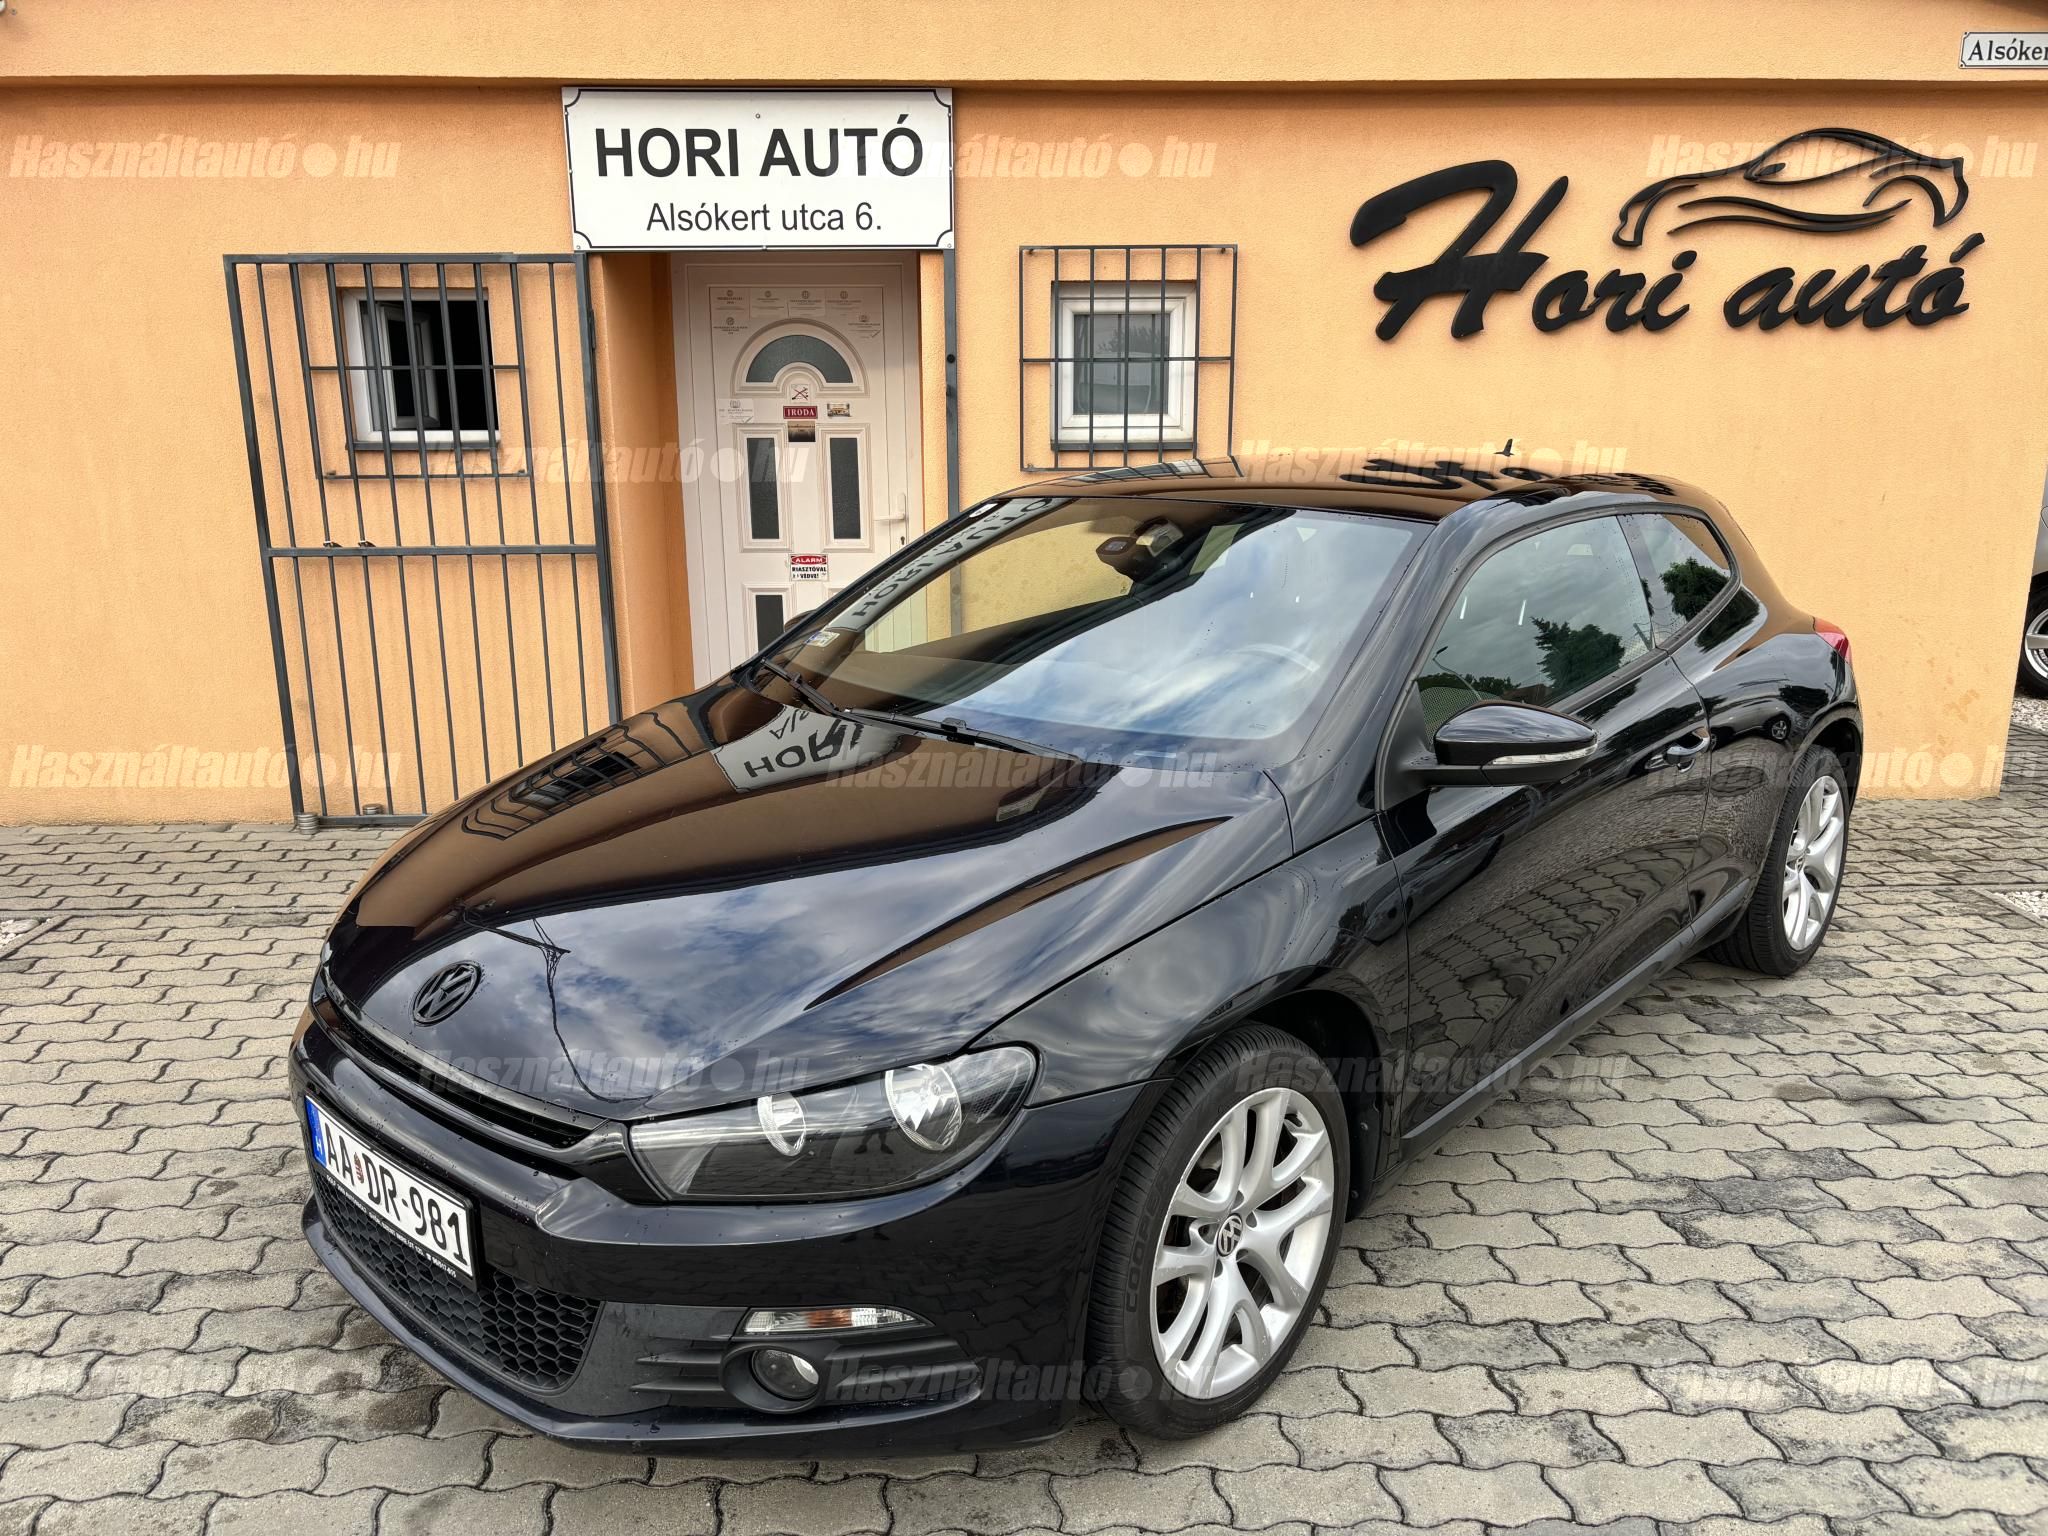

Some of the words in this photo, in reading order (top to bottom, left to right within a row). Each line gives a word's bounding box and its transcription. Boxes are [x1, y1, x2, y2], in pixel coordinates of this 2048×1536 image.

[595, 128, 739, 178] HORI
[759, 114, 923, 178] AUTÓ
[646, 202, 771, 232] Alsókert
[781, 203, 844, 231] utca
[855, 202, 882, 231] 6.
[1350, 159, 1690, 342] Hori
[1723, 233, 1986, 333] autó
[786, 408, 815, 417] IRODA
